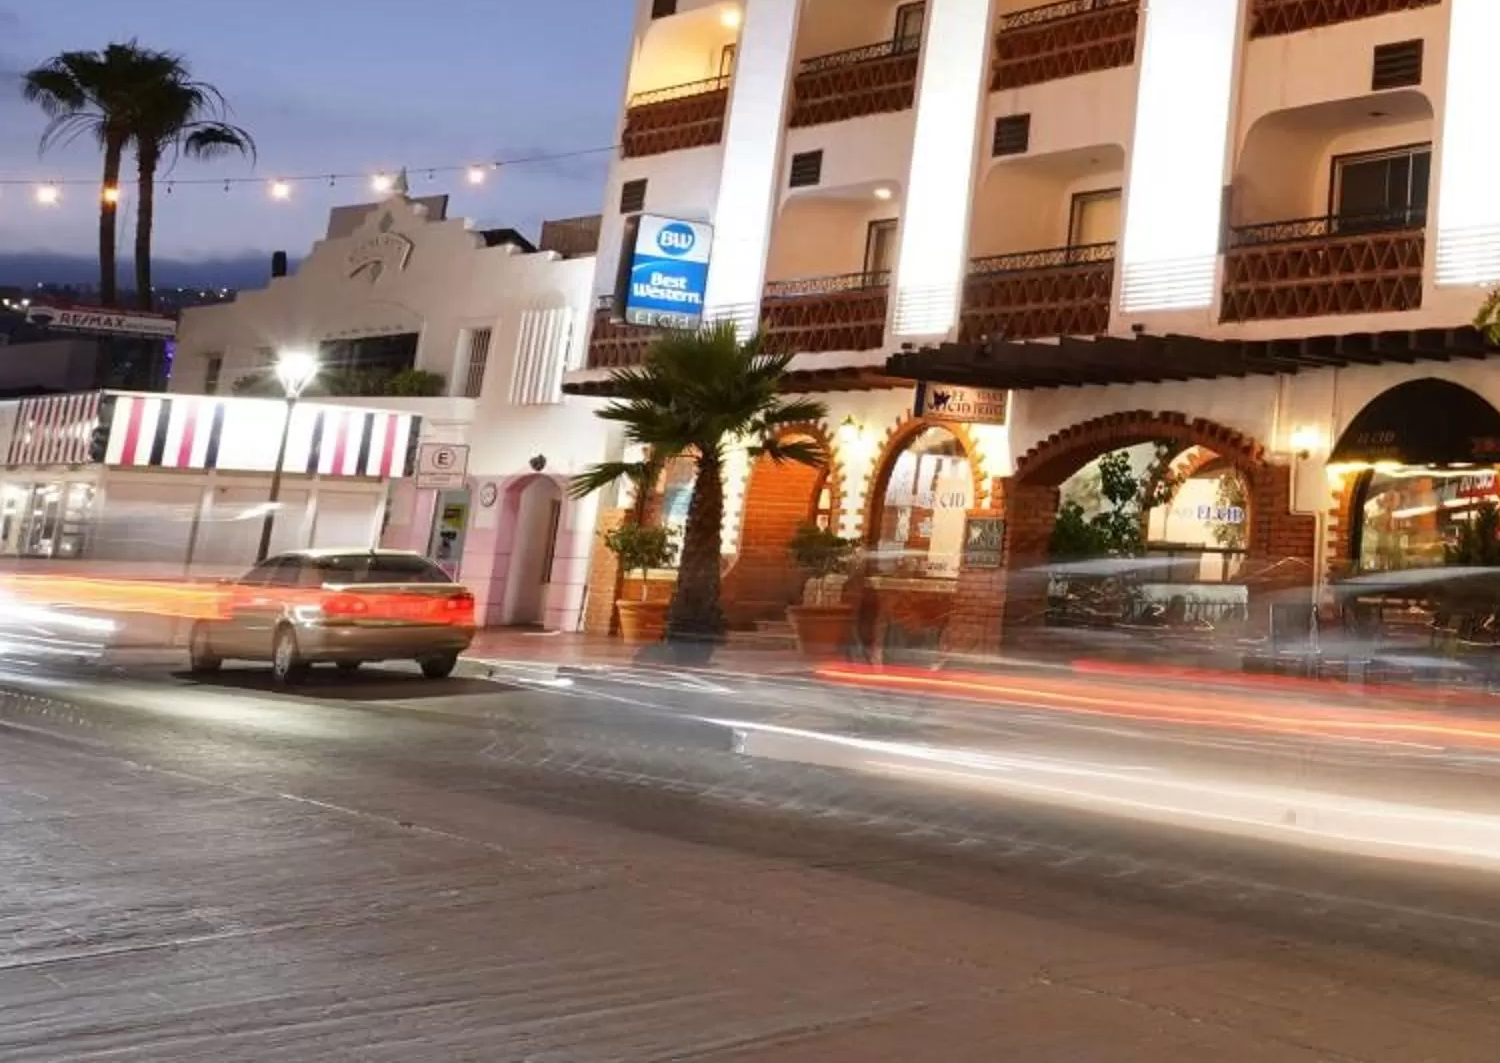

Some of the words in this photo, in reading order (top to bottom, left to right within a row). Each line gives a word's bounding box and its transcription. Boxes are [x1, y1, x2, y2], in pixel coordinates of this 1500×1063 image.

[660, 230, 693, 249] BW
[651, 271, 688, 289] Best
[59, 312, 126, 328] RE/MAX
[437, 452, 449, 465] E
[939, 492, 965, 508] CID
